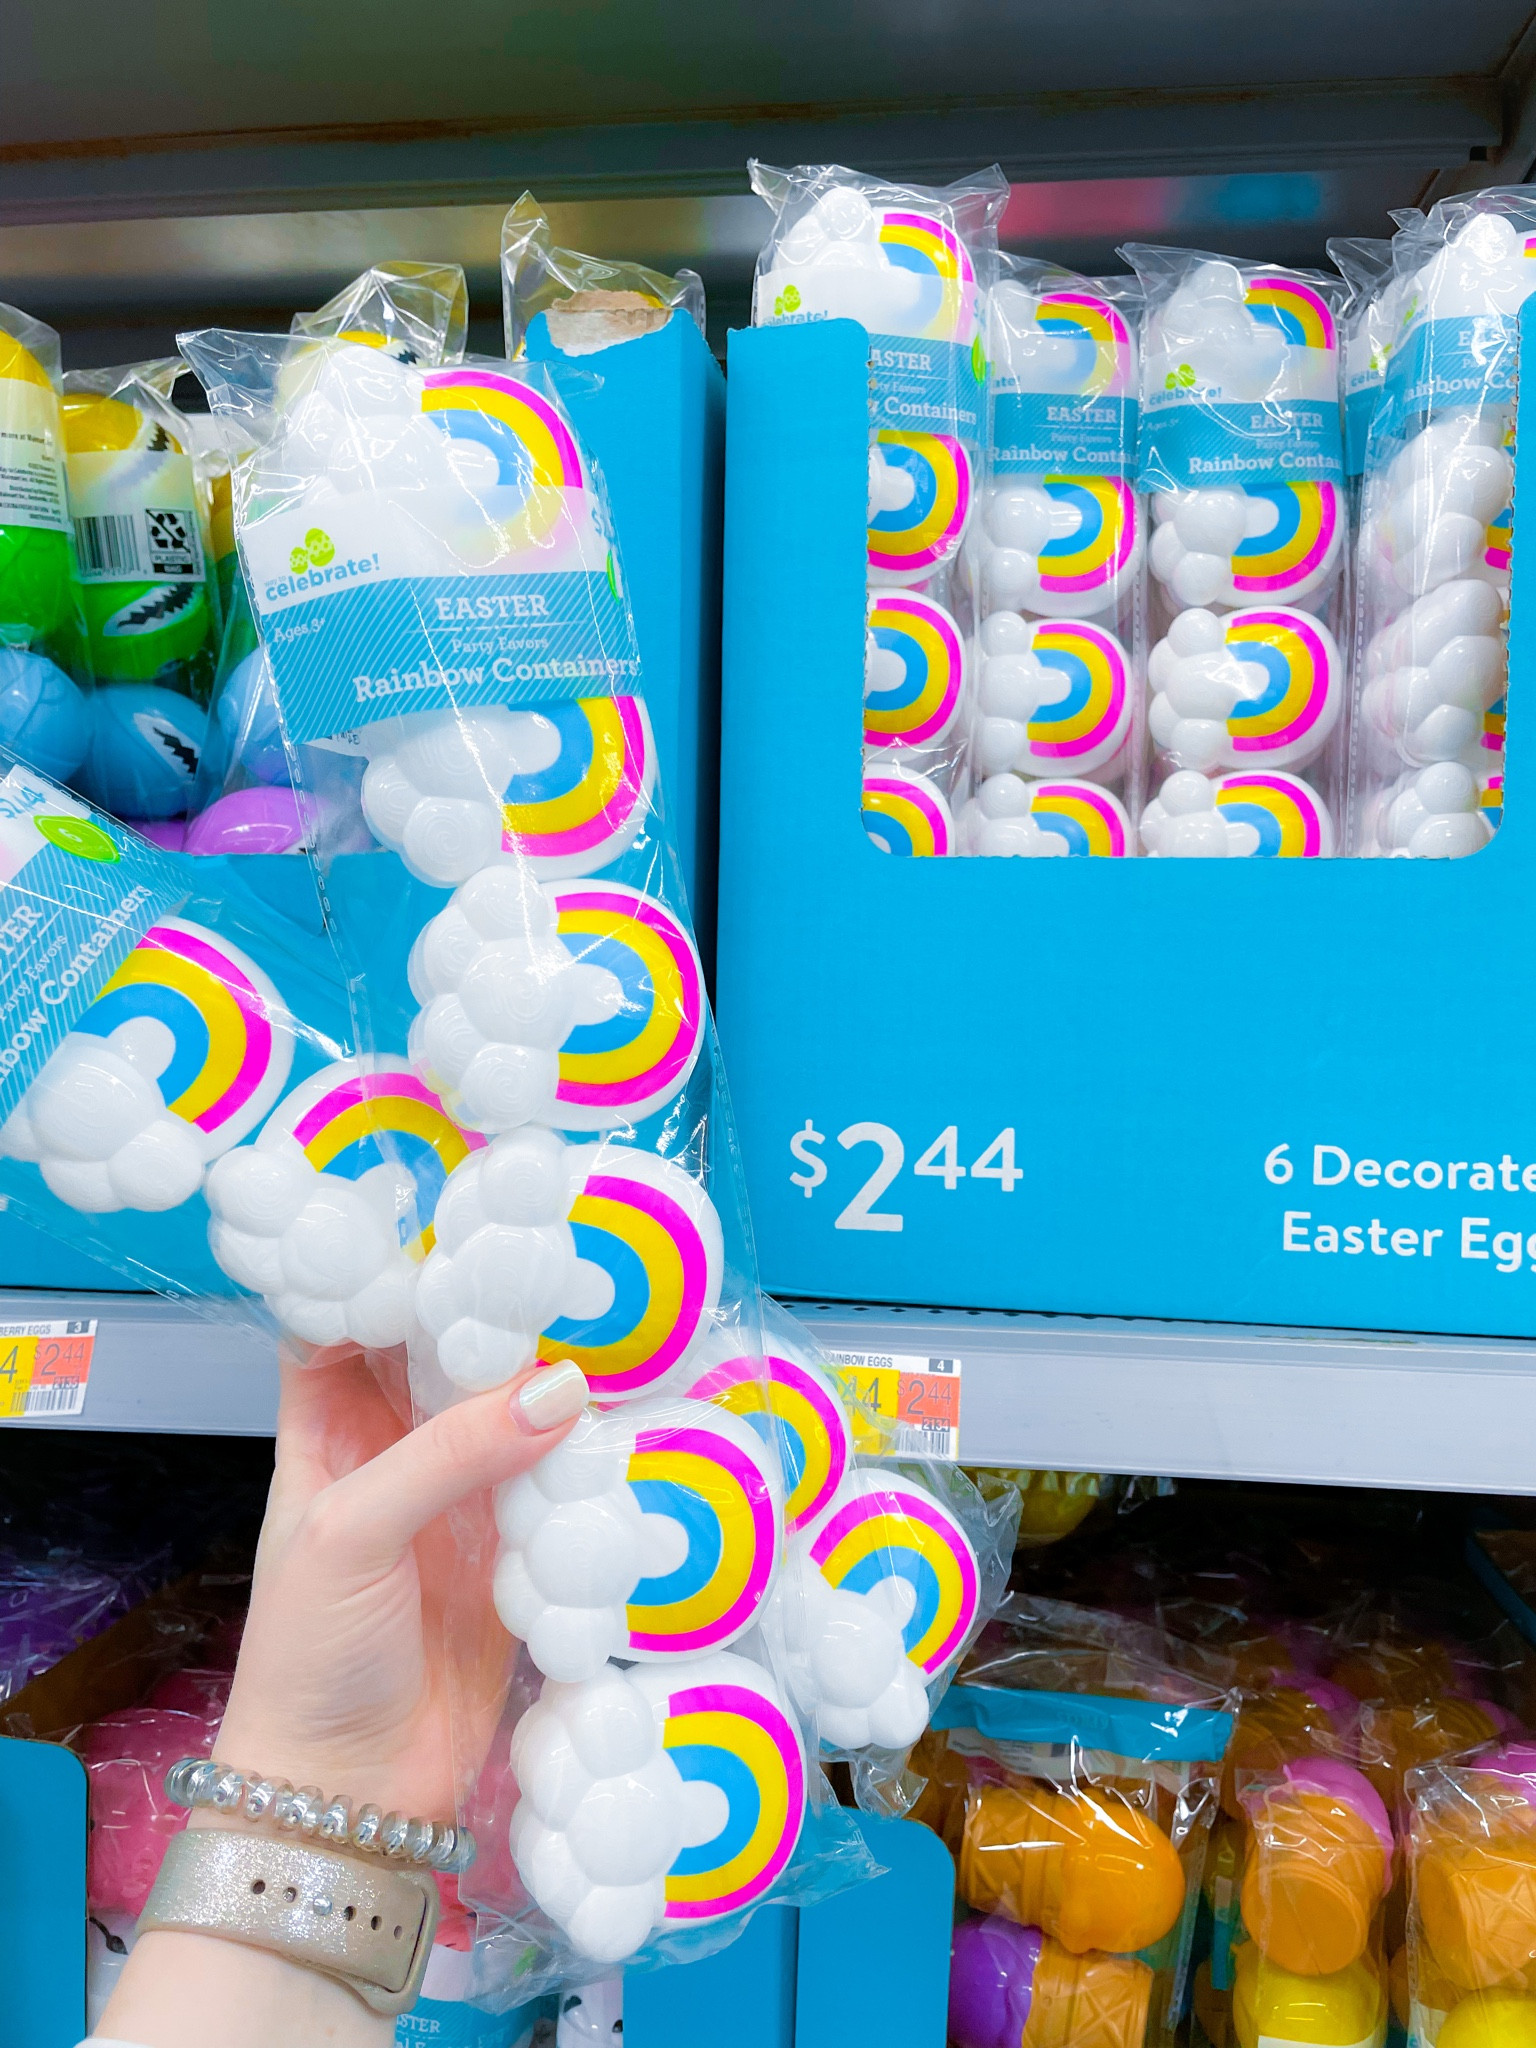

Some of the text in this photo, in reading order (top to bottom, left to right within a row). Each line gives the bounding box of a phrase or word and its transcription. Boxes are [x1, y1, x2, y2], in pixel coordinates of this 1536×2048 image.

[884, 396, 977, 425] Containers
[1047, 406, 1117, 423] EASTER
[1189, 454, 1274, 474] Rainbow
[266, 553, 380, 601] celebrate!
[435, 594, 549, 621] EASTER
[273, 622, 309, 642] Ages
[452, 636, 549, 655] Party Favors
[352, 654, 639, 702] Rainbow Containers
[40, 885, 153, 1005] Containers
[24, 935, 68, 981] Favors
[1264, 1143, 1293, 1185] 6
[1283, 1210, 1443, 1257] Easter
[27, 1324, 51, 1335] EGGS
[74, 1322, 82, 1333] 3
[868, 1356, 893, 1368] EGGS
[937, 1360, 945, 1371] 4
